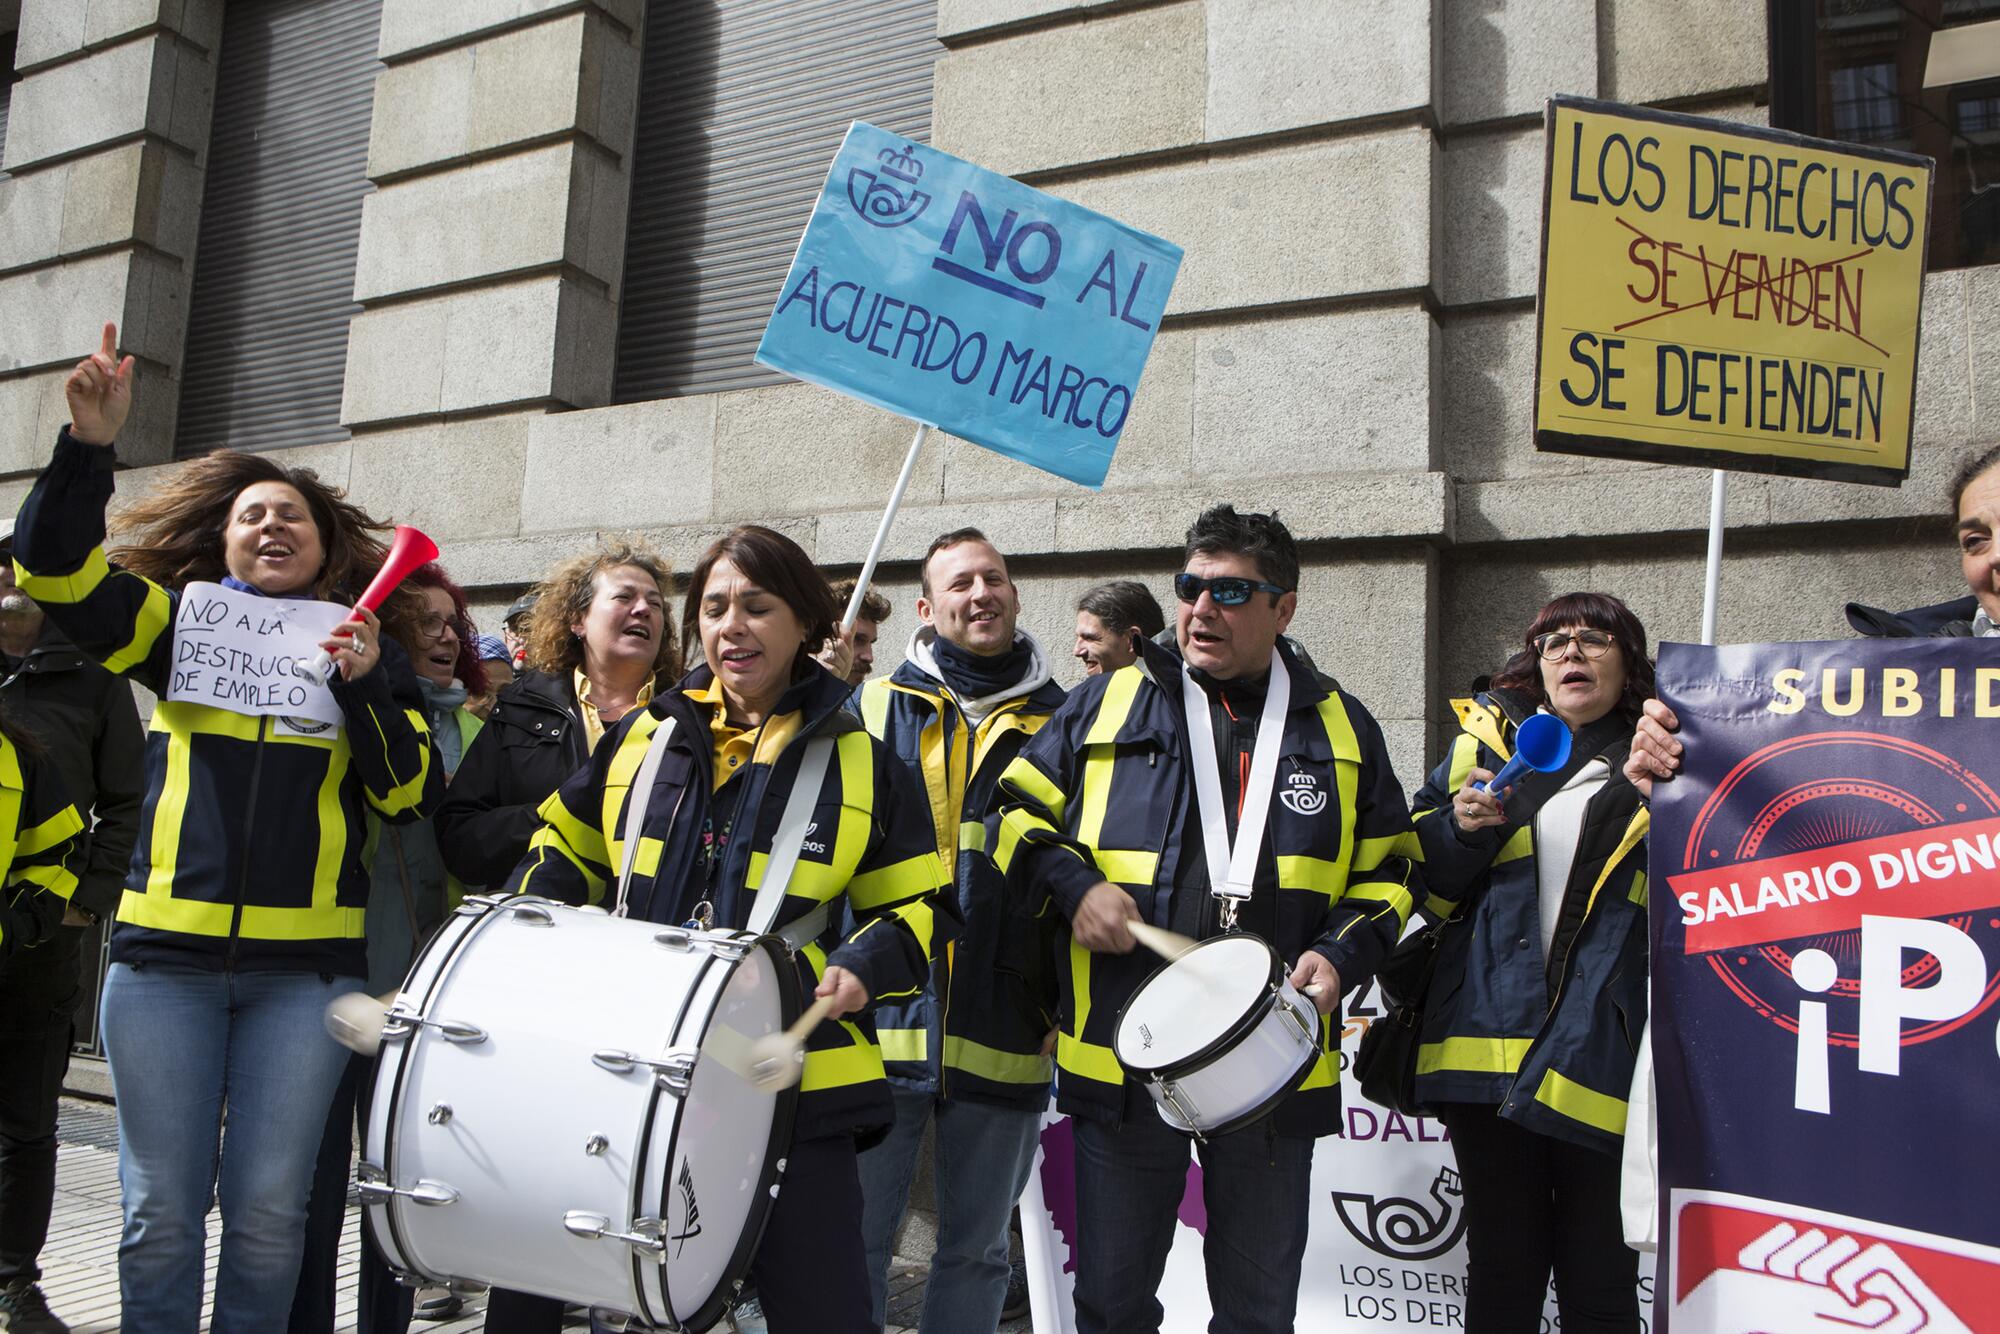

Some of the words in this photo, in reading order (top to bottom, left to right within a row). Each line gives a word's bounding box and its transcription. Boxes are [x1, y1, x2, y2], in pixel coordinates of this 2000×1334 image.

[1569, 122, 1666, 213] LOS
[1688, 144, 1915, 250] DERECHOS
[938, 190, 1062, 285] NO
[1075, 249, 1151, 331] AL
[1627, 236, 1683, 309] SE
[1698, 245, 1864, 336] VENDEN
[777, 266, 988, 385] ACUERDO
[988, 340, 1131, 438] MARCO
[1559, 332, 1626, 411] SE
[1656, 344, 1885, 443] DEFIENDEN
[178, 640, 332, 678] DESTRUCC
[180, 599, 229, 625] NO
[235, 614, 250, 631] A
[257, 618, 284, 635] LA
[173, 670, 202, 693] DE
[213, 676, 306, 707] EMPLEO
[1679, 861, 1862, 926] SALARIO
[1868, 831, 2000, 890] DIGN
[1340, 1264, 1393, 1289] LOS
[1345, 1294, 1397, 1321] LOS
[1406, 1300, 1465, 1328] DER
